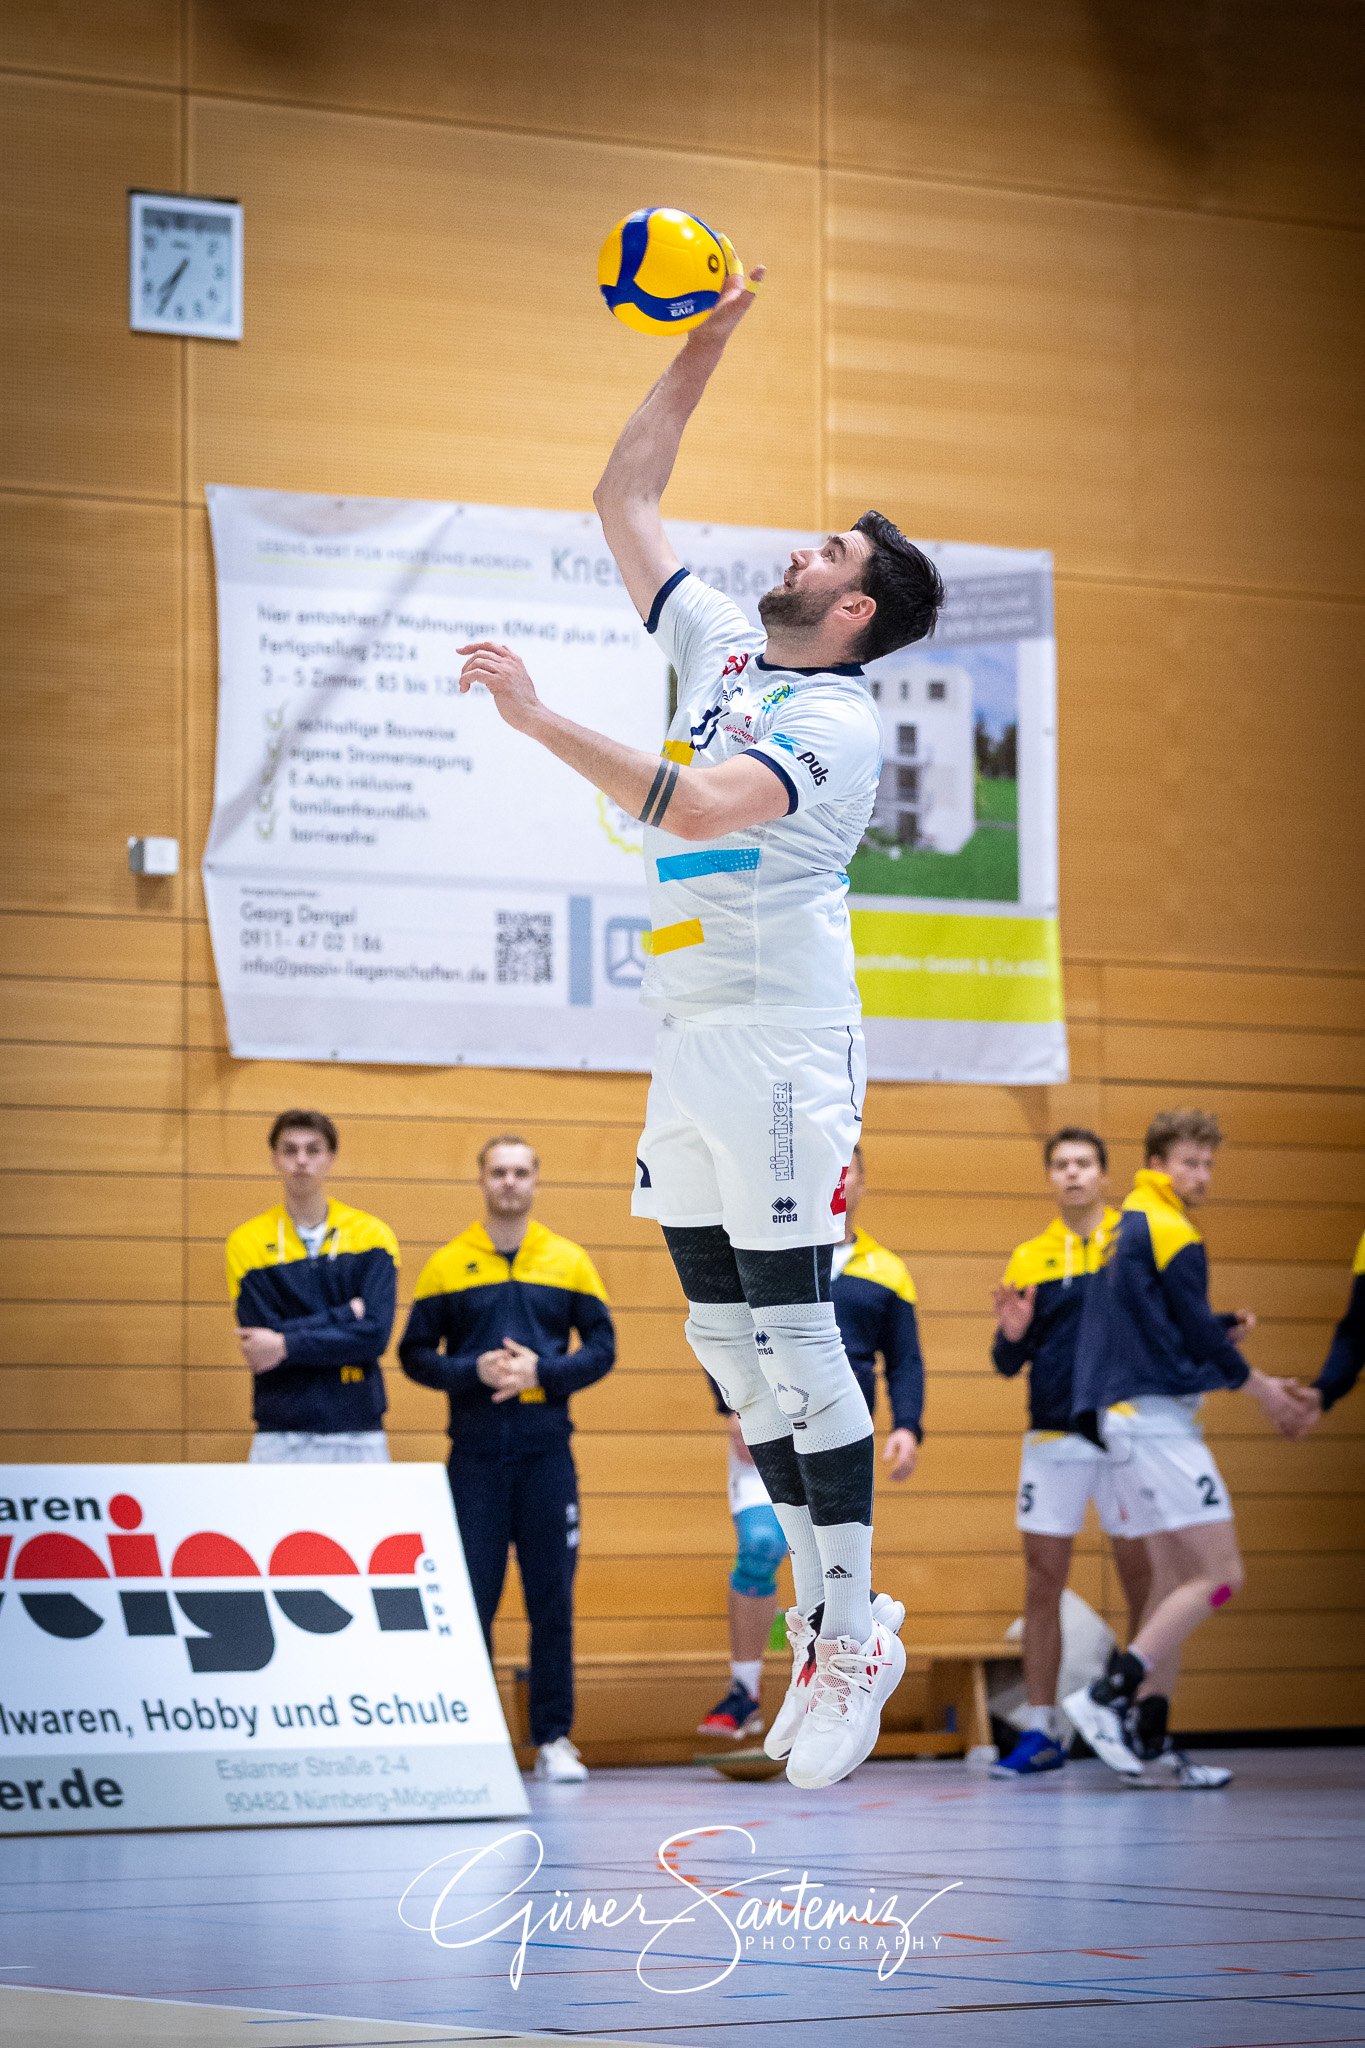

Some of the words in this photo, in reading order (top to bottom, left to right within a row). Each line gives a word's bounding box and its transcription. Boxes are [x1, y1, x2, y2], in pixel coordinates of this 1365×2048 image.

[796, 751, 829, 787] puls
[1196, 1474, 1220, 1506] 2
[0, 1493, 427, 1673] eiger
[0, 1703, 134, 1739] lwaren,
[142, 1697, 258, 1737] Hobby
[274, 1696, 340, 1728] und
[351, 1693, 470, 1727] Schule
[0, 1767, 125, 1811] er.de
